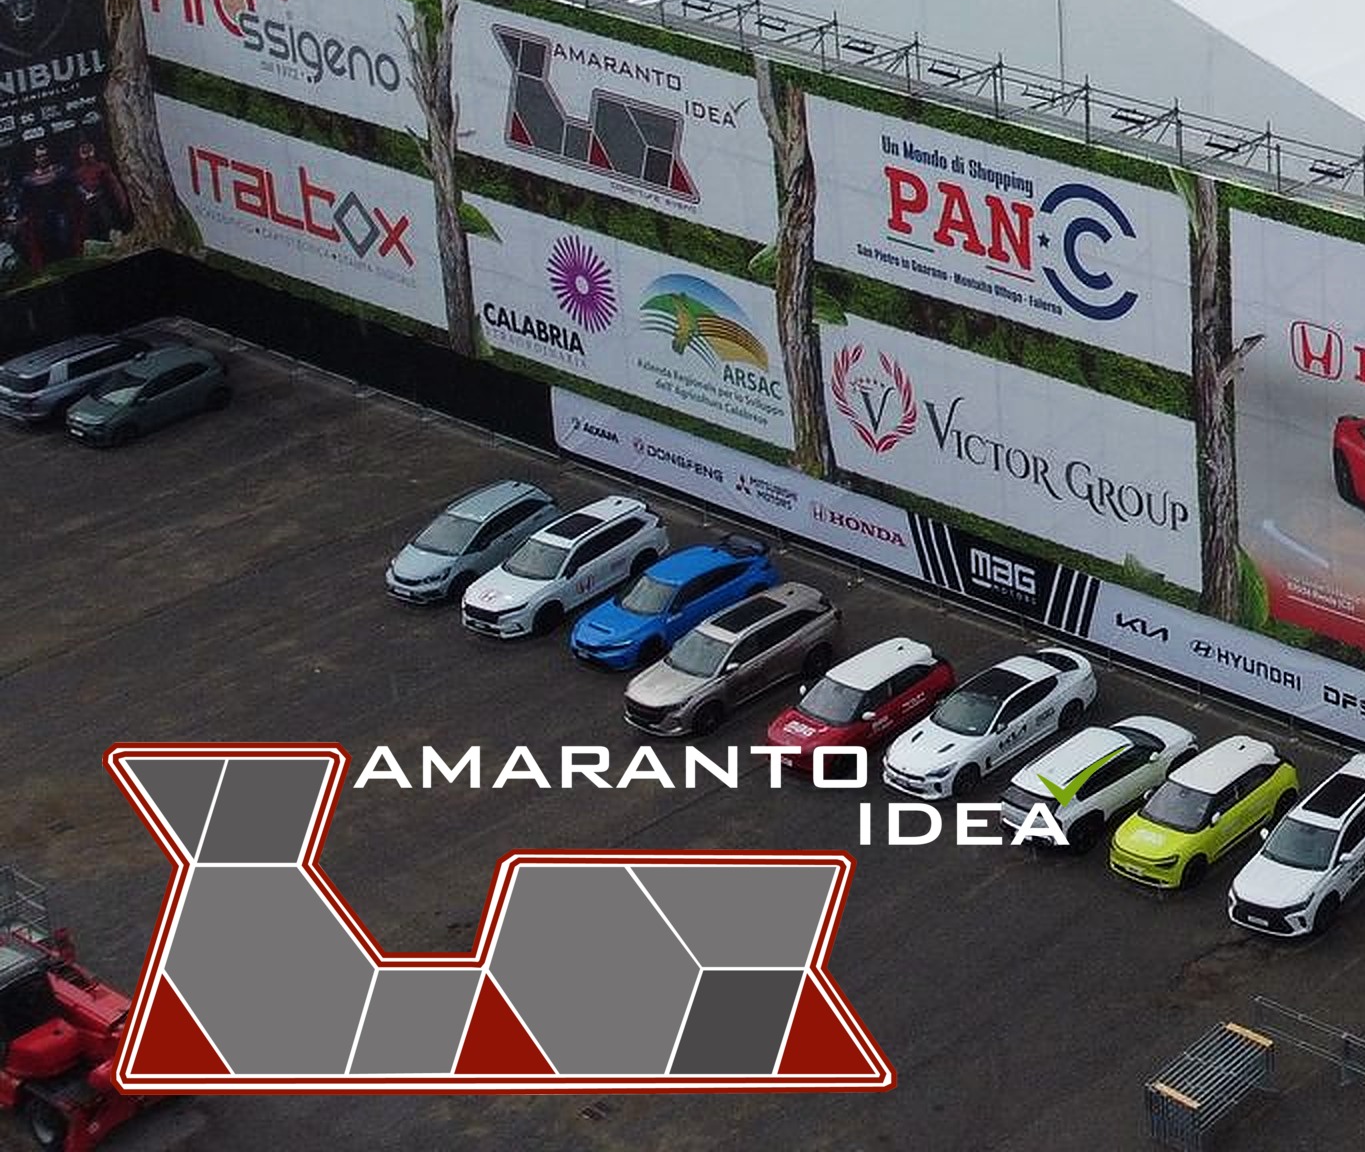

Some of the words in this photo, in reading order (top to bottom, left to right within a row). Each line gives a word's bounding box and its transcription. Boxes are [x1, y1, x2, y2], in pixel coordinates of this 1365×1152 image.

[552, 43, 682, 92] AMARANTO
[685, 99, 738, 129] IDEA
[880, 135, 900, 157] Un
[901, 141, 947, 171] Mondo
[950, 156, 965, 176] di
[968, 161, 1034, 199] Shopping
[884, 165, 1035, 272] PAN
[483, 303, 585, 356] CALABRIA
[723, 364, 783, 400] ARSAC
[647, 444, 725, 484] DONGFENG
[829, 510, 907, 548] HONDA
[1115, 611, 1169, 643] KIA
[1217, 649, 1301, 693] HYUNDAI
